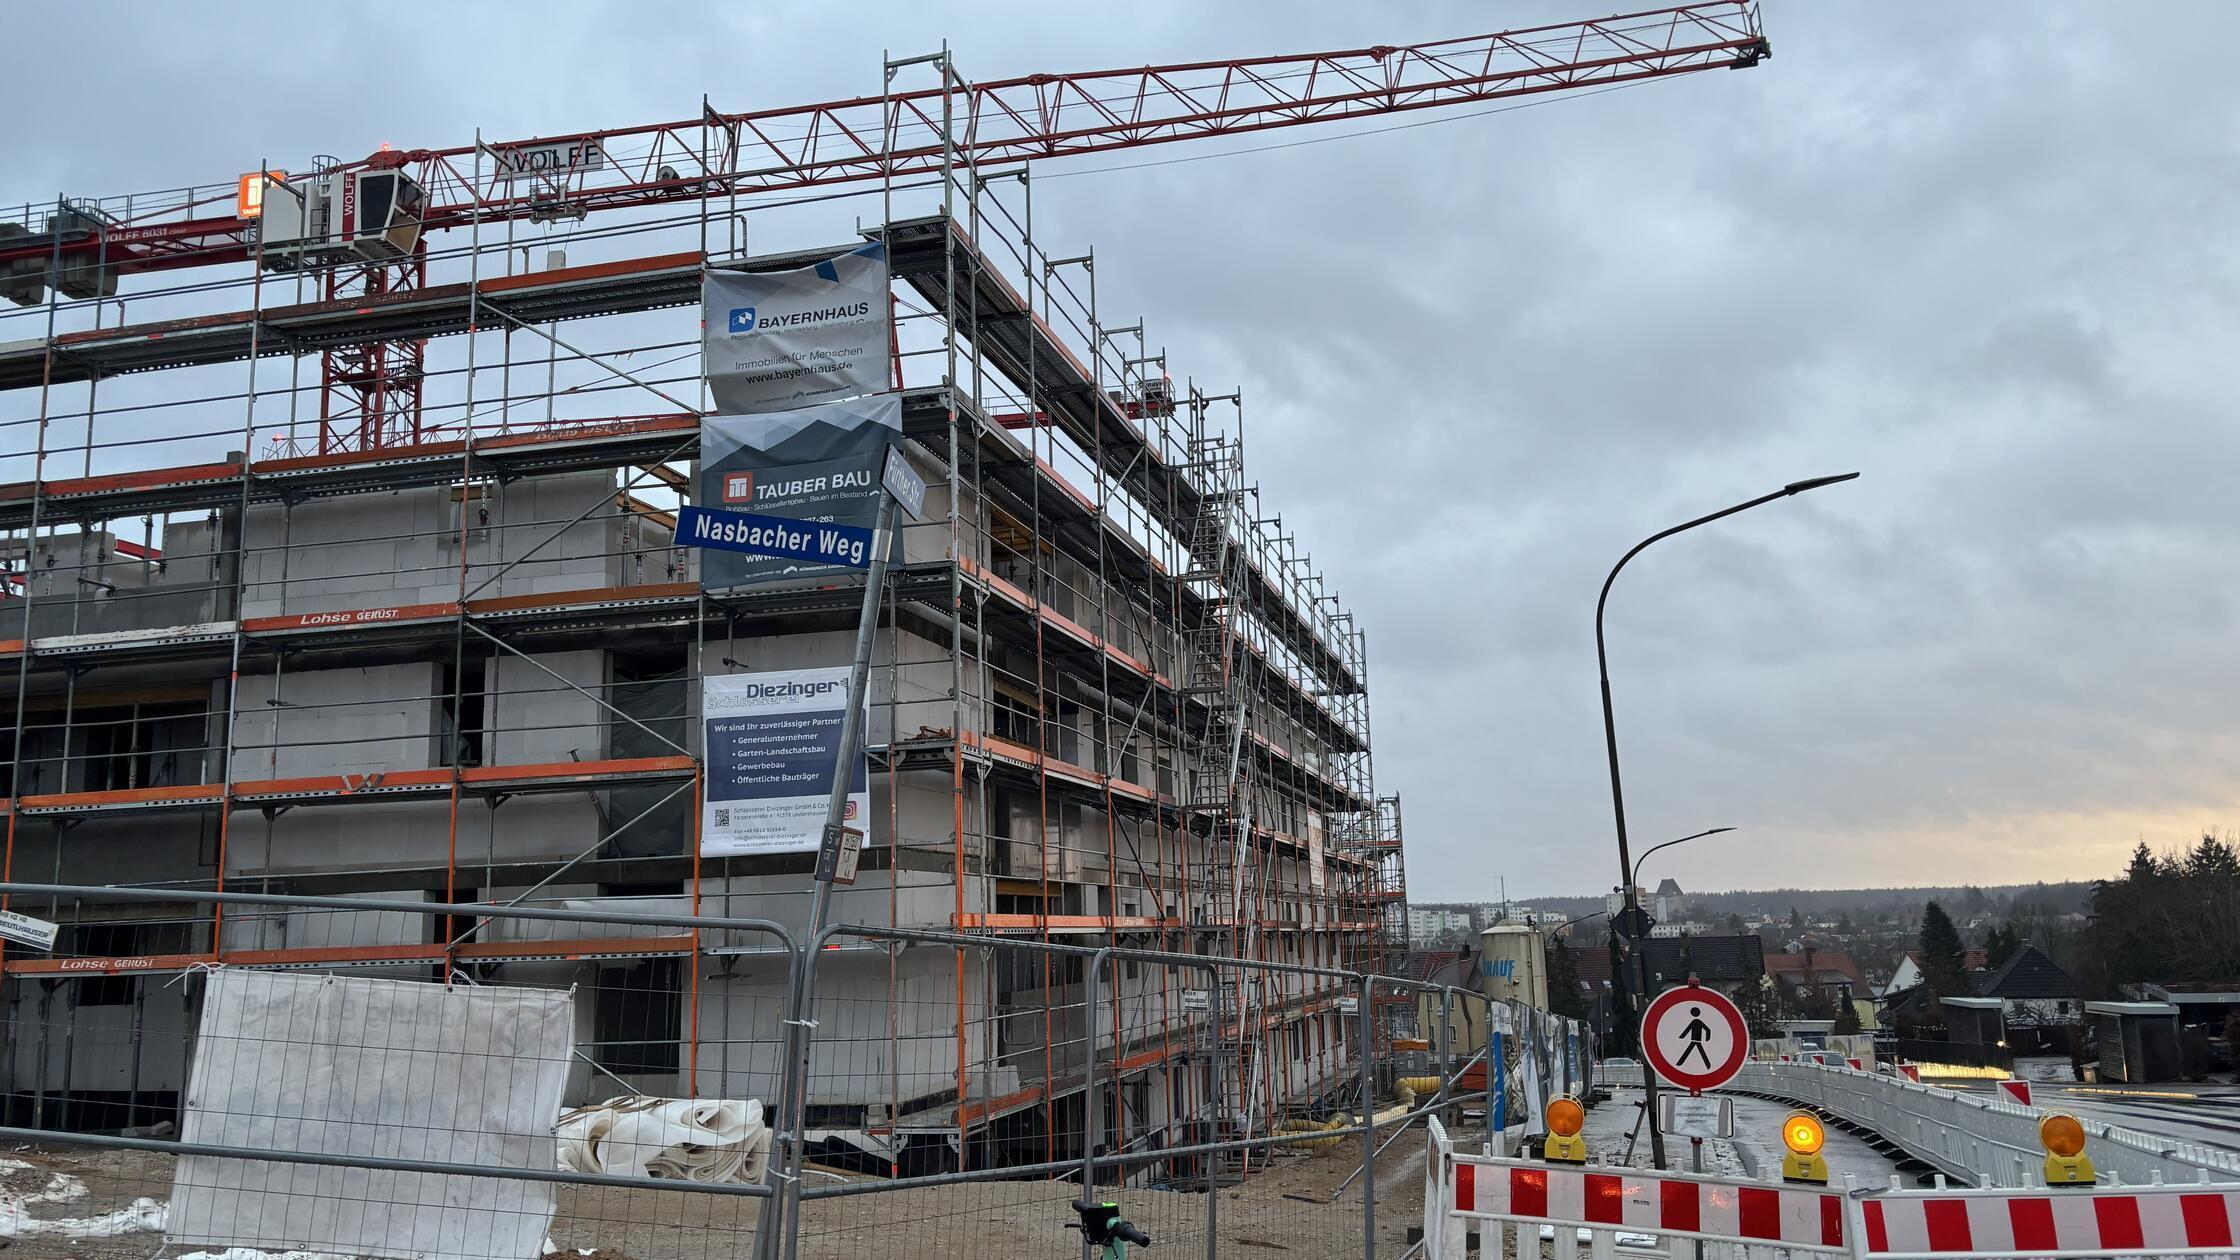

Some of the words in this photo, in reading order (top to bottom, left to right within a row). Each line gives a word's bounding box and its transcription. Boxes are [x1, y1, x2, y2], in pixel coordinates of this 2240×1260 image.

[504, 145, 598, 172] WOLFF
[344, 174, 354, 216] WOLFF
[142, 227, 167, 238] 6031
[758, 302, 869, 329] BAYERNHAUS
[735, 354, 790, 371] Immobilien
[792, 351, 806, 362] für
[809, 347, 863, 361] Menschen
[745, 360, 853, 385] www.bayernhaus.de
[756, 477, 827, 500] TAUBER
[831, 470, 871, 489] BAU
[839, 490, 868, 499] Bestand
[695, 513, 812, 552] Nasbacher
[819, 529, 864, 565] Weg
[300, 614, 351, 625] Lohse
[356, 608, 399, 620] GERÜST
[746, 681, 839, 699] Diezinger
[707, 694, 800, 710] Schlosserei
[714, 725, 727, 733] Wir
[728, 723, 745, 732] sind
[746, 722, 758, 730] Ihr
[759, 718, 811, 730] zuverlässiger
[812, 718, 841, 726] Partner
[737, 733, 818, 744] Generalunternehmer
[737, 745, 826, 758] Garten-Landschaftsbau
[737, 762, 786, 771] Gewerbebau
[737, 774, 780, 784] Öffentliche
[781, 772, 820, 782] Bauträger
[61, 960, 109, 969] Lohse
[114, 957, 154, 968] GERÜST
